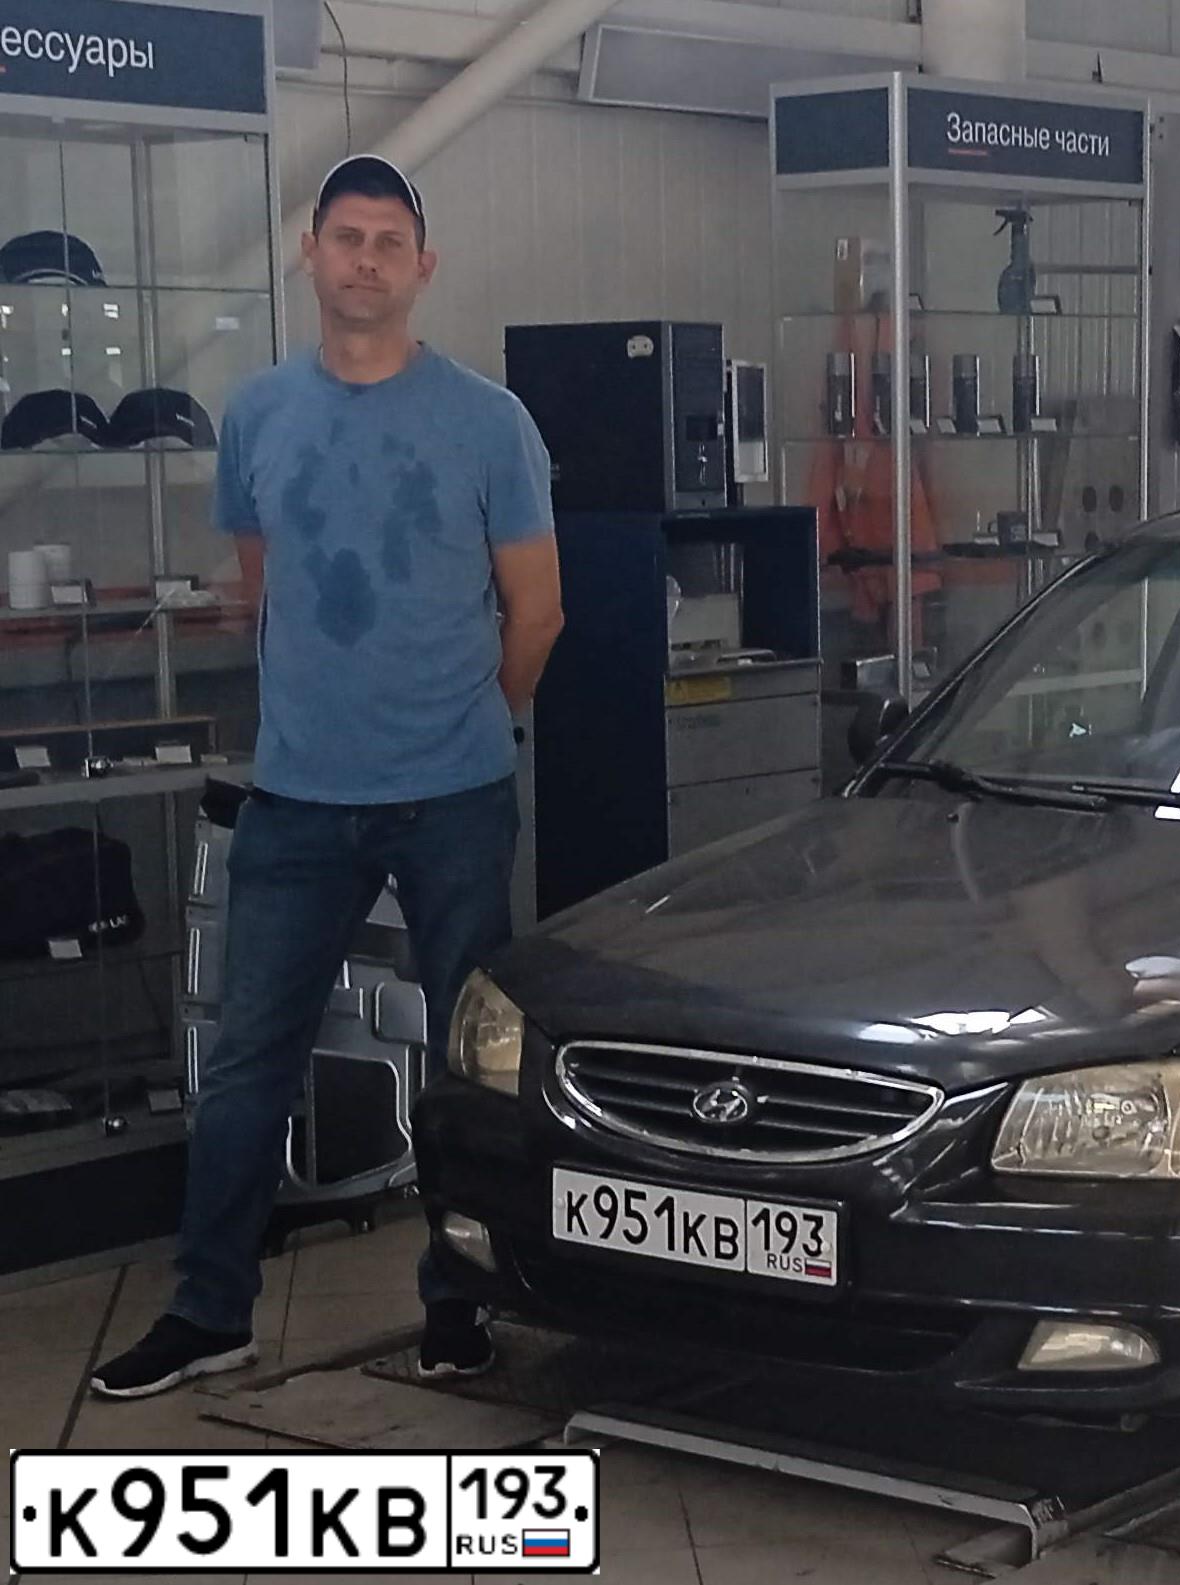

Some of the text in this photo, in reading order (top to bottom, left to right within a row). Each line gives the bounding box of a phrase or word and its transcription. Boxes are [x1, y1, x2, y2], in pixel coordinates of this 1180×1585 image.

[0, 25, 155, 77] ессуары
[946, 111, 1110, 157] Запасные части
[565, 1184, 825, 1261] К951КВ 193
[766, 1252, 804, 1273] RUS
